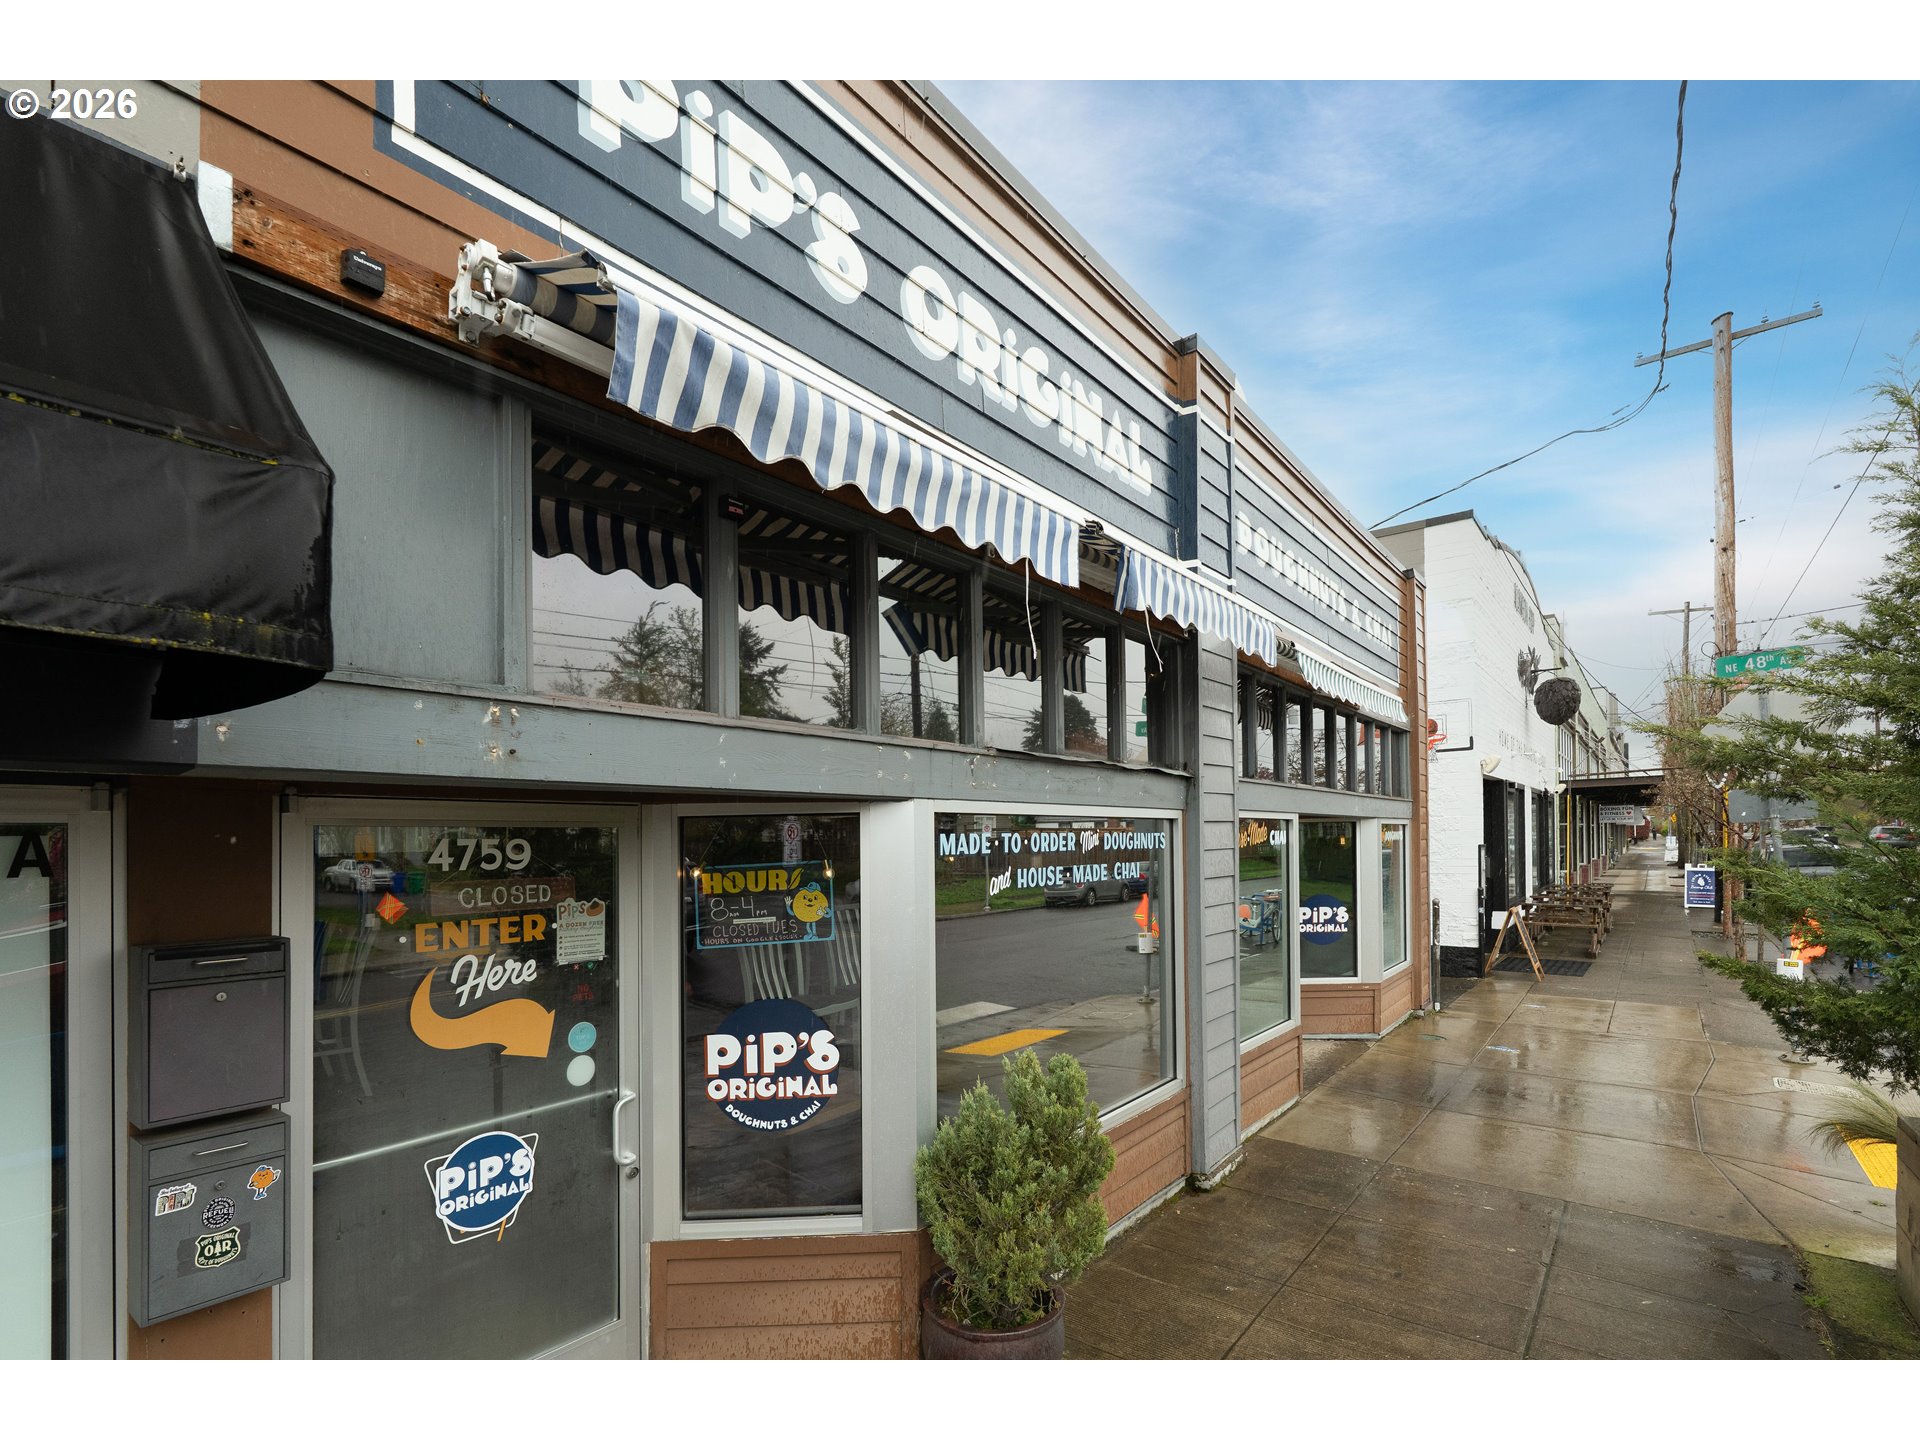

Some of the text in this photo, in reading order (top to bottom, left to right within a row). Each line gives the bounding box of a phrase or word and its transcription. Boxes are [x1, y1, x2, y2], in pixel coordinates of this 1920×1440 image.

[1236, 511, 1347, 622] DOUGHNUTS
[1365, 610, 1392, 651] CHAI
[1725, 664, 1738, 673] NE
[1745, 655, 1775, 670] 48th
[940, 829, 1166, 856] MADE TO ORDER Mini DOUGHNUTS
[1270, 830, 1286, 846] CHAI
[6, 831, 54, 878] A
[427, 838, 532, 872] 4759
[702, 868, 804, 895] HOURS
[989, 861, 1140, 896] and HOUSE MADE CHAI
[458, 885, 551, 909] CLOSED
[415, 914, 547, 953] ENTER
[566, 921, 587, 929] DOZEN
[713, 924, 759, 938] CLOSED
[765, 919, 798, 934] TUES
[704, 937, 729, 945] HOURS
[450, 953, 538, 1008] Here
[725, 1100, 821, 1130] DOUGHNUTS & CHAI
[203, 1206, 234, 1220] REFUEL
